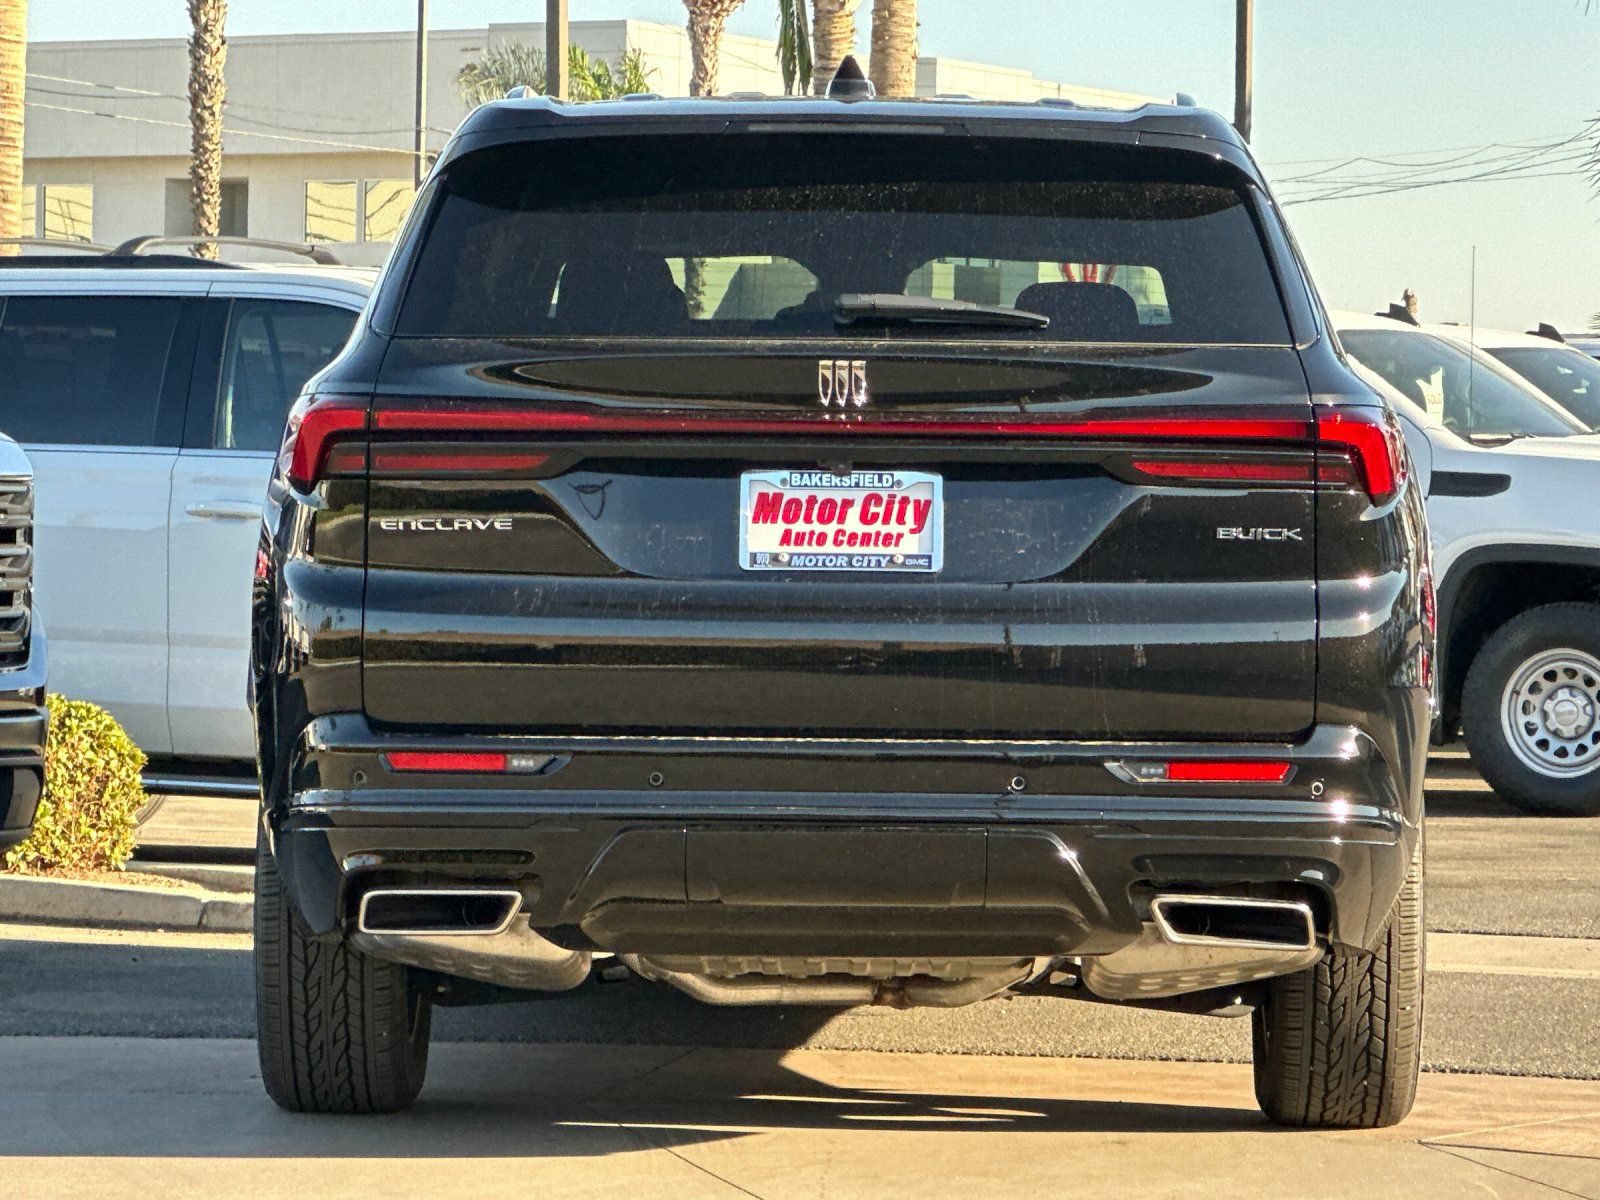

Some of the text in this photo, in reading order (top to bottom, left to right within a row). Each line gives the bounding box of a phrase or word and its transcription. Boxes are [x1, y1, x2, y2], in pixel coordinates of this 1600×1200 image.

[790, 474, 893, 488] BAKERSFIELD
[752, 492, 931, 534] Motor City
[380, 518, 512, 530] ENCLAVE
[779, 528, 904, 547] Auto Center
[1216, 527, 1302, 541] BUICK
[791, 556, 847, 567] MOTOR
[851, 557, 890, 568] CITY
